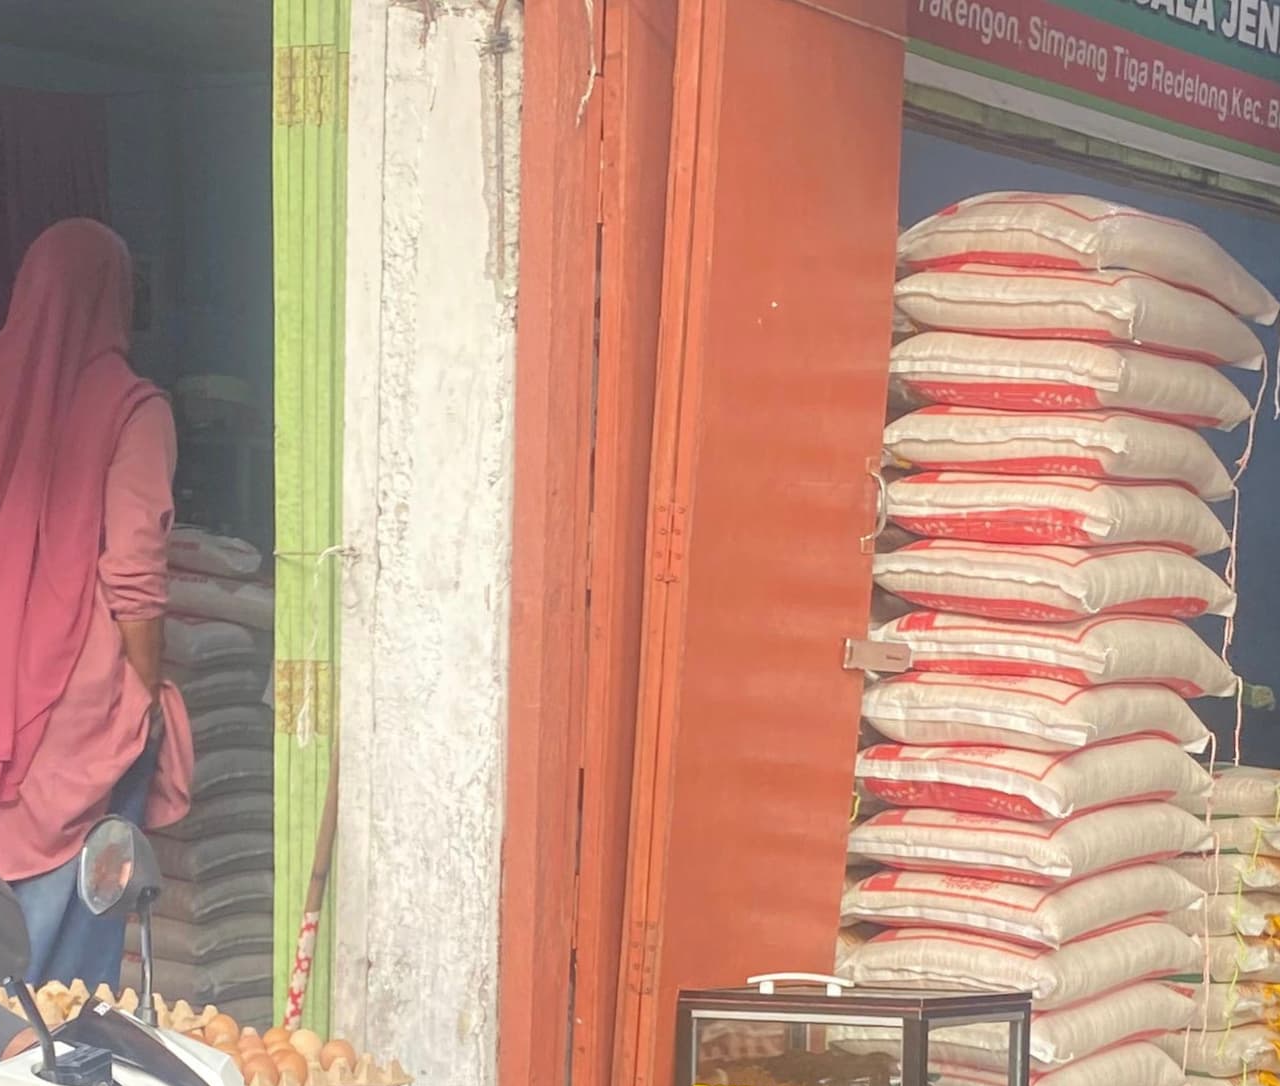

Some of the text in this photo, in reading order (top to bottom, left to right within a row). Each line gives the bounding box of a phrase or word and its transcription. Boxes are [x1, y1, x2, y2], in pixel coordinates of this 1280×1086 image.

[1028, 15, 1108, 83] Simpang
[1113, 45, 1148, 92] Tiga
[1152, 60, 1228, 121] Redelong
[1231, 86, 1264, 126] Kec.
